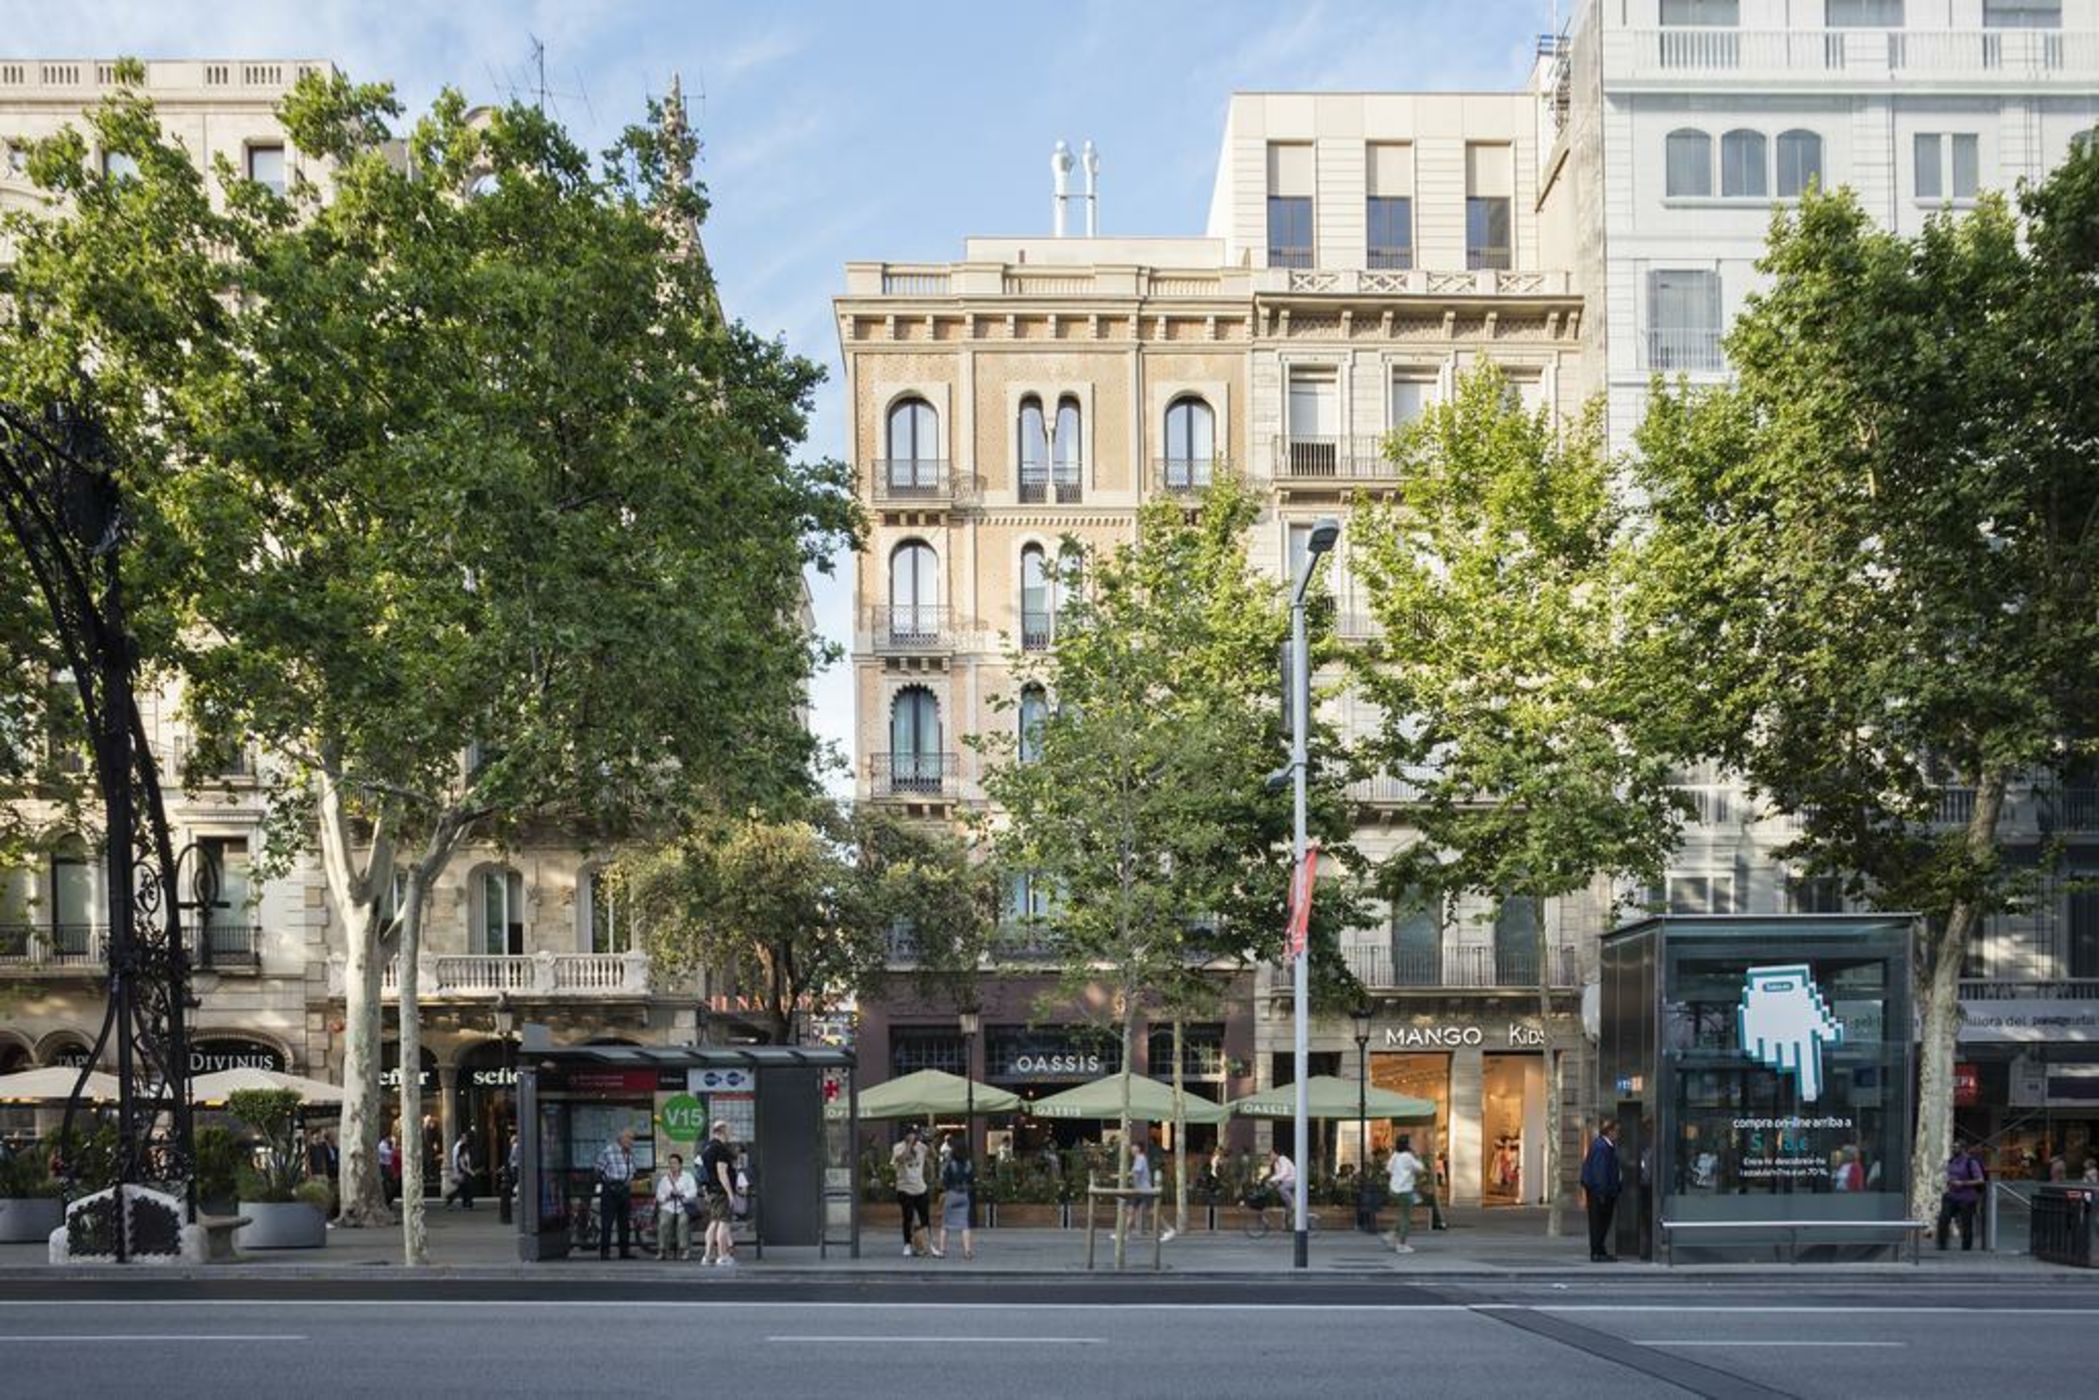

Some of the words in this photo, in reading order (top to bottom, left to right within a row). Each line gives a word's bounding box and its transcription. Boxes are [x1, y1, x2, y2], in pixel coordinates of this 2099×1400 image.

[1385, 1027, 1482, 1045] MANGO
[1017, 1055, 1099, 1072] OASSIS
[665, 1108, 703, 1127] V15
[1732, 1118, 1774, 1131] compra
[1812, 1116, 1843, 1129] arriba
[1844, 1118, 1852, 1129] a
